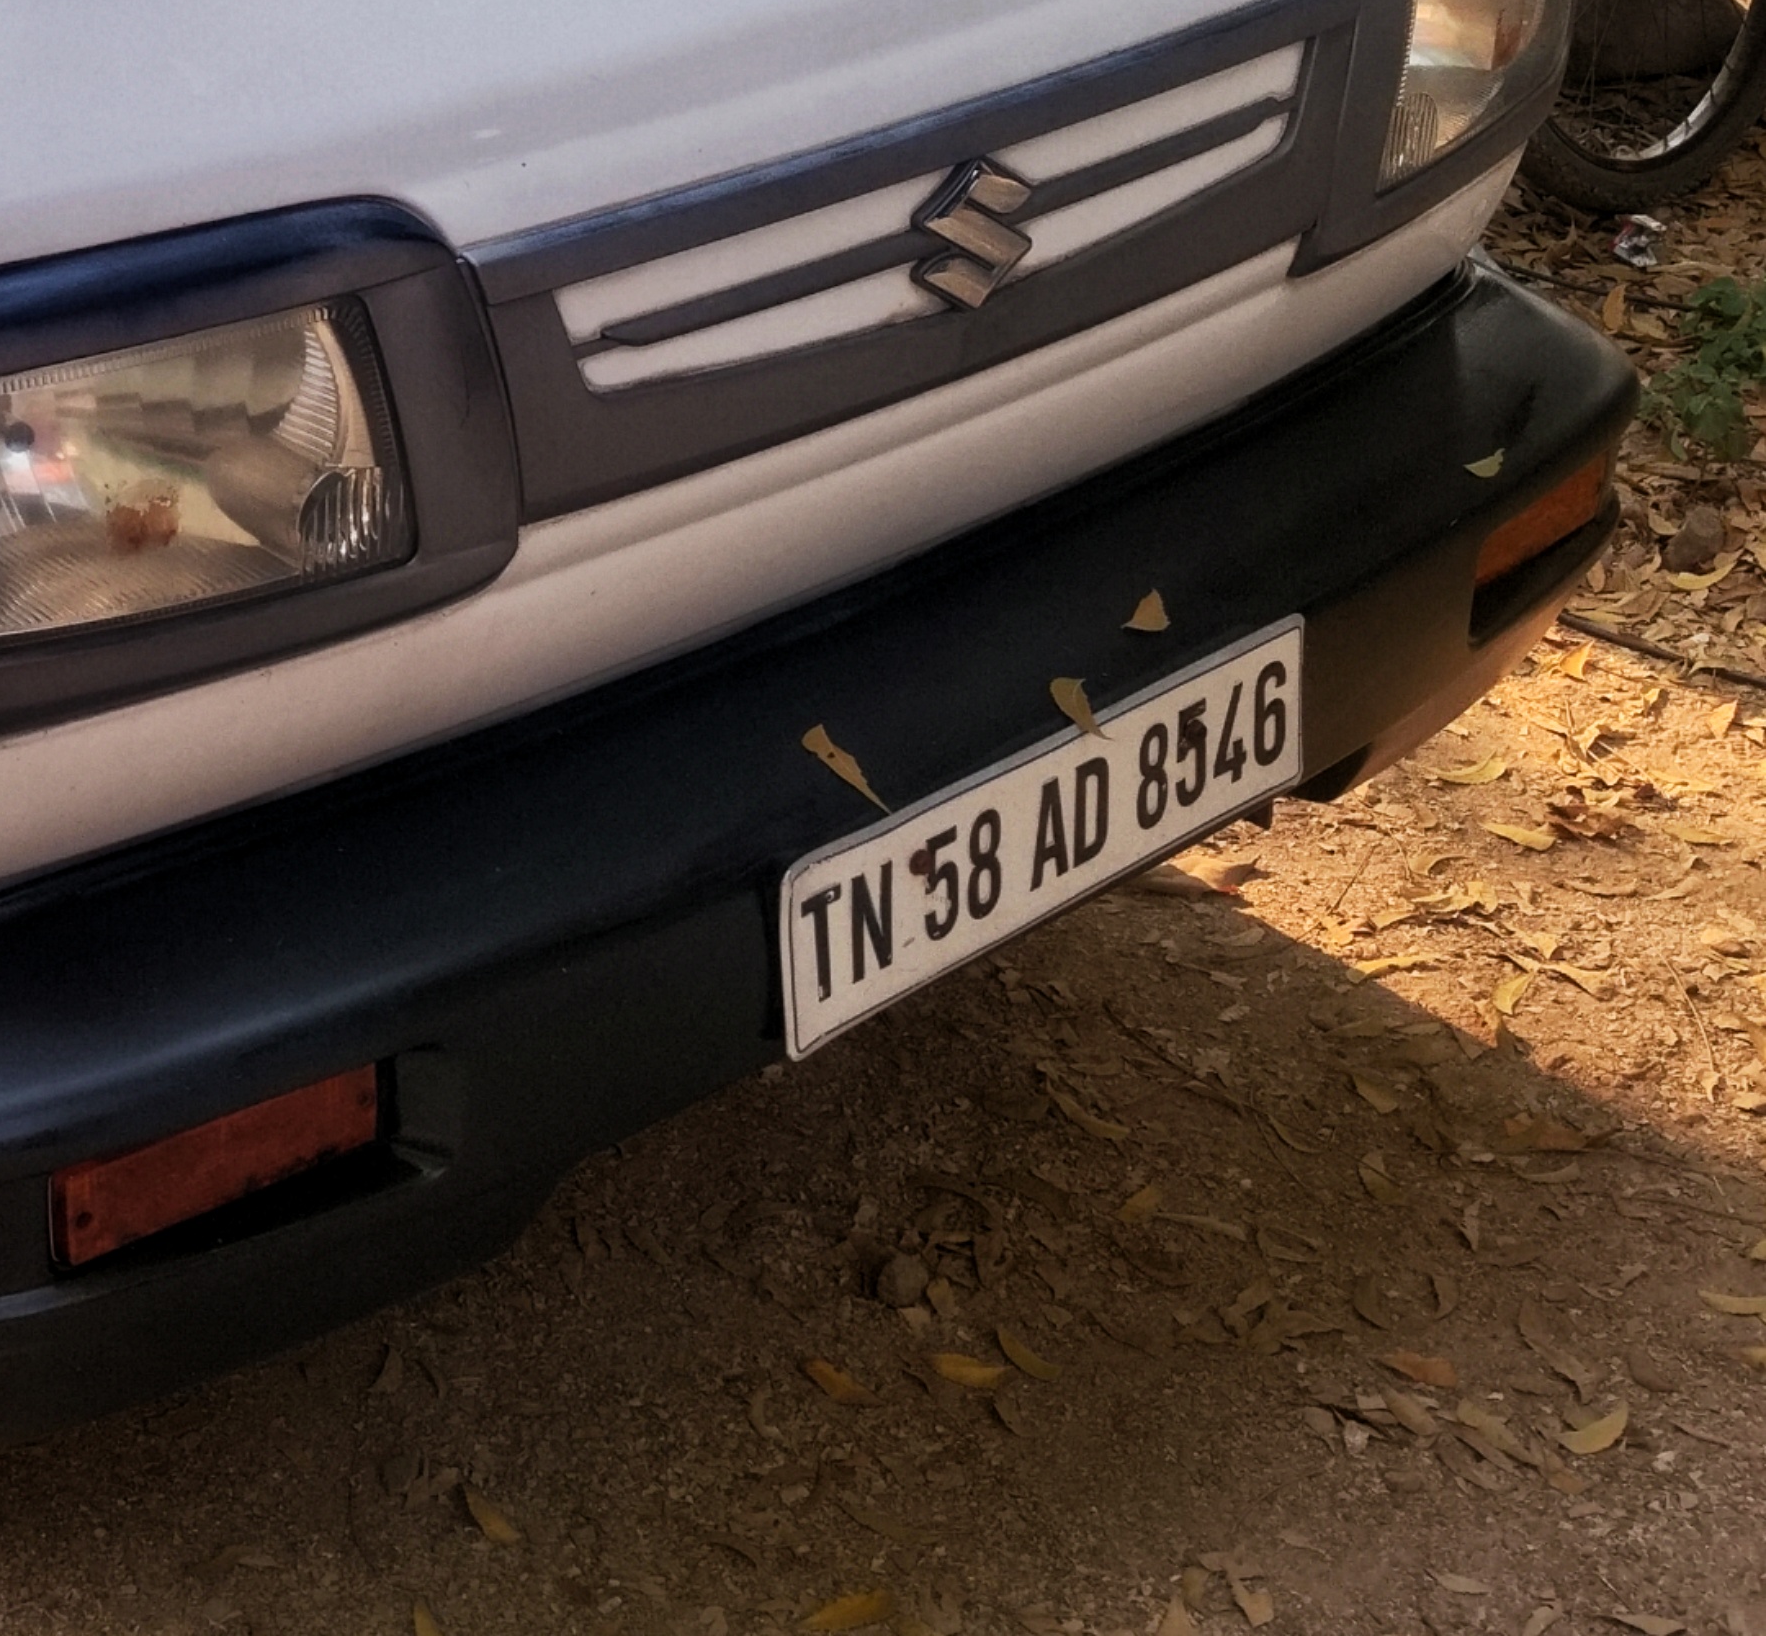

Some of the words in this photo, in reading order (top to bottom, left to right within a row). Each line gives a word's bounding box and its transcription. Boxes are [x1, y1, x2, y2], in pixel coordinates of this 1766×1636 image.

[800, 861, 894, 1003] TN
[923, 808, 1002, 941] 58
[1030, 755, 1110, 892] AD
[1136, 660, 1287, 831] 8546
